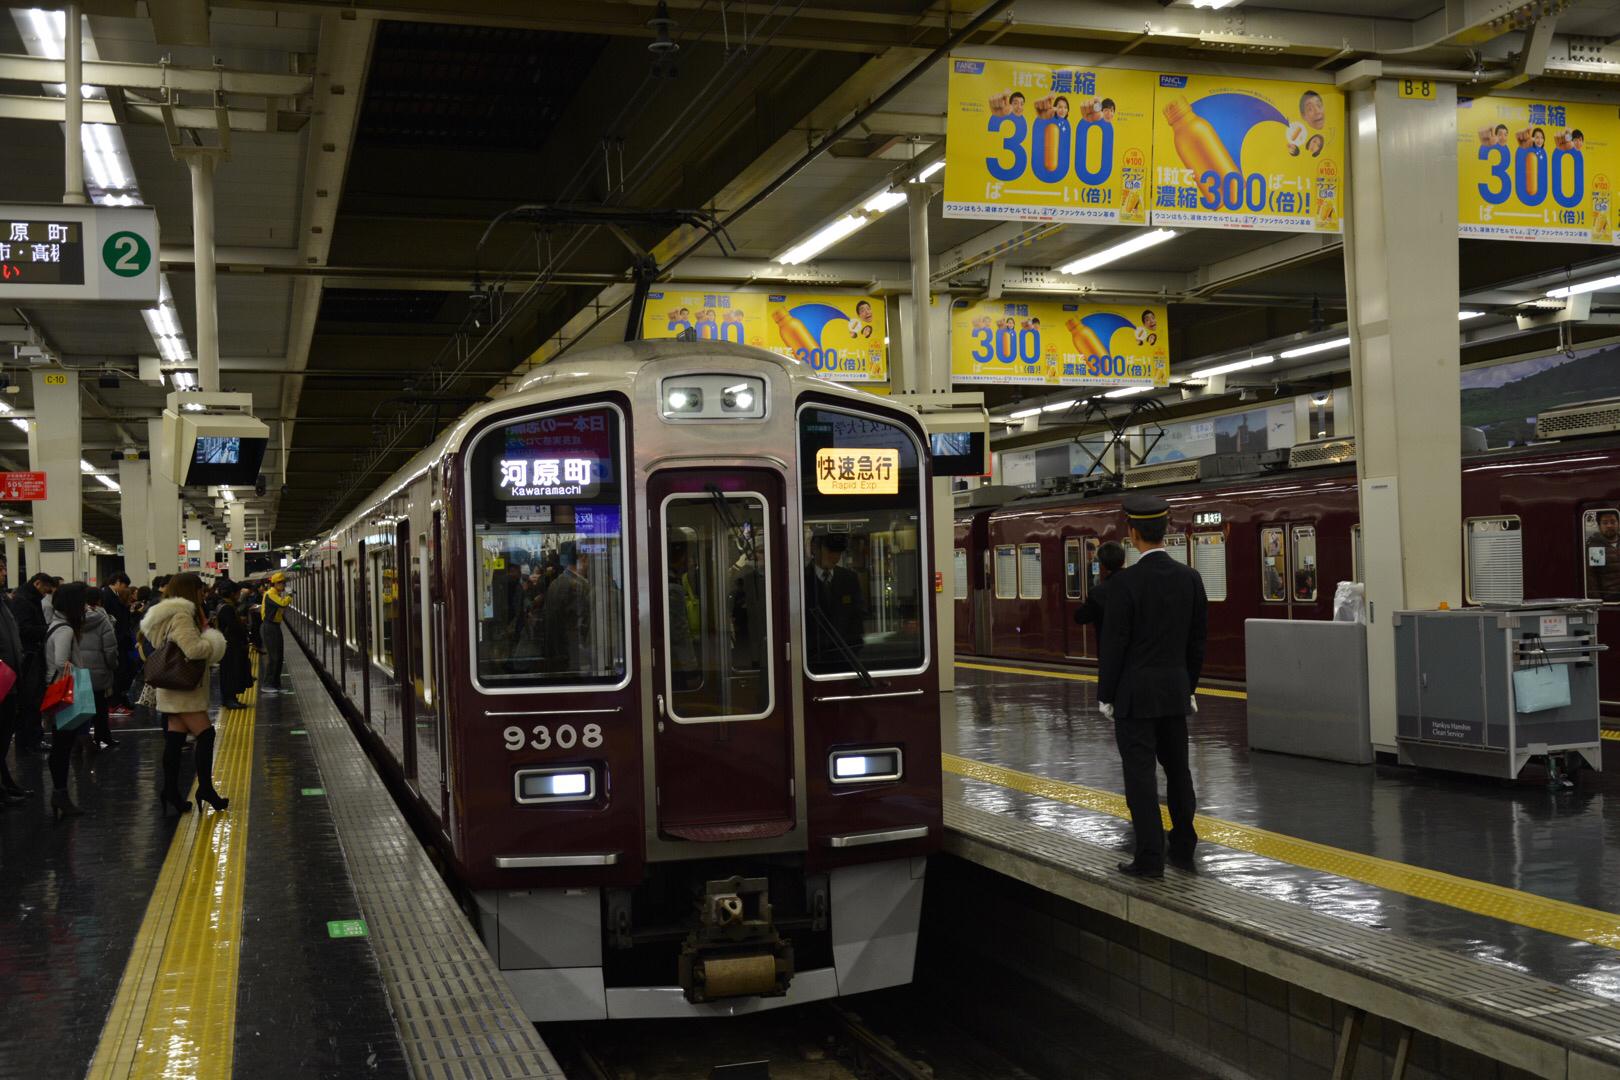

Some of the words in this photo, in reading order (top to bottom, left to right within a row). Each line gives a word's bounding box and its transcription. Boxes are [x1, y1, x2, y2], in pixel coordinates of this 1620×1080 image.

[1160, 76, 1182, 84] FANCL
[1404, 80, 1430, 97] B-8
[985, 114, 1115, 186] 300
[1477, 143, 1585, 209] 300
[1155, 185, 1198, 209] 濃縮
[1199, 169, 1267, 212] 300
[114, 236, 140, 271] 2
[795, 347, 838, 372] 300
[971, 328, 1041, 366] 300
[1087, 354, 1125, 377] 300
[46, 374, 65, 385] C-10
[500, 458, 592, 488] 河原町
[817, 455, 892, 481] 快速急行
[511, 485, 582, 497] Kawaramachi
[832, 480, 857, 491] Rapid
[503, 723, 604, 751] 9308
